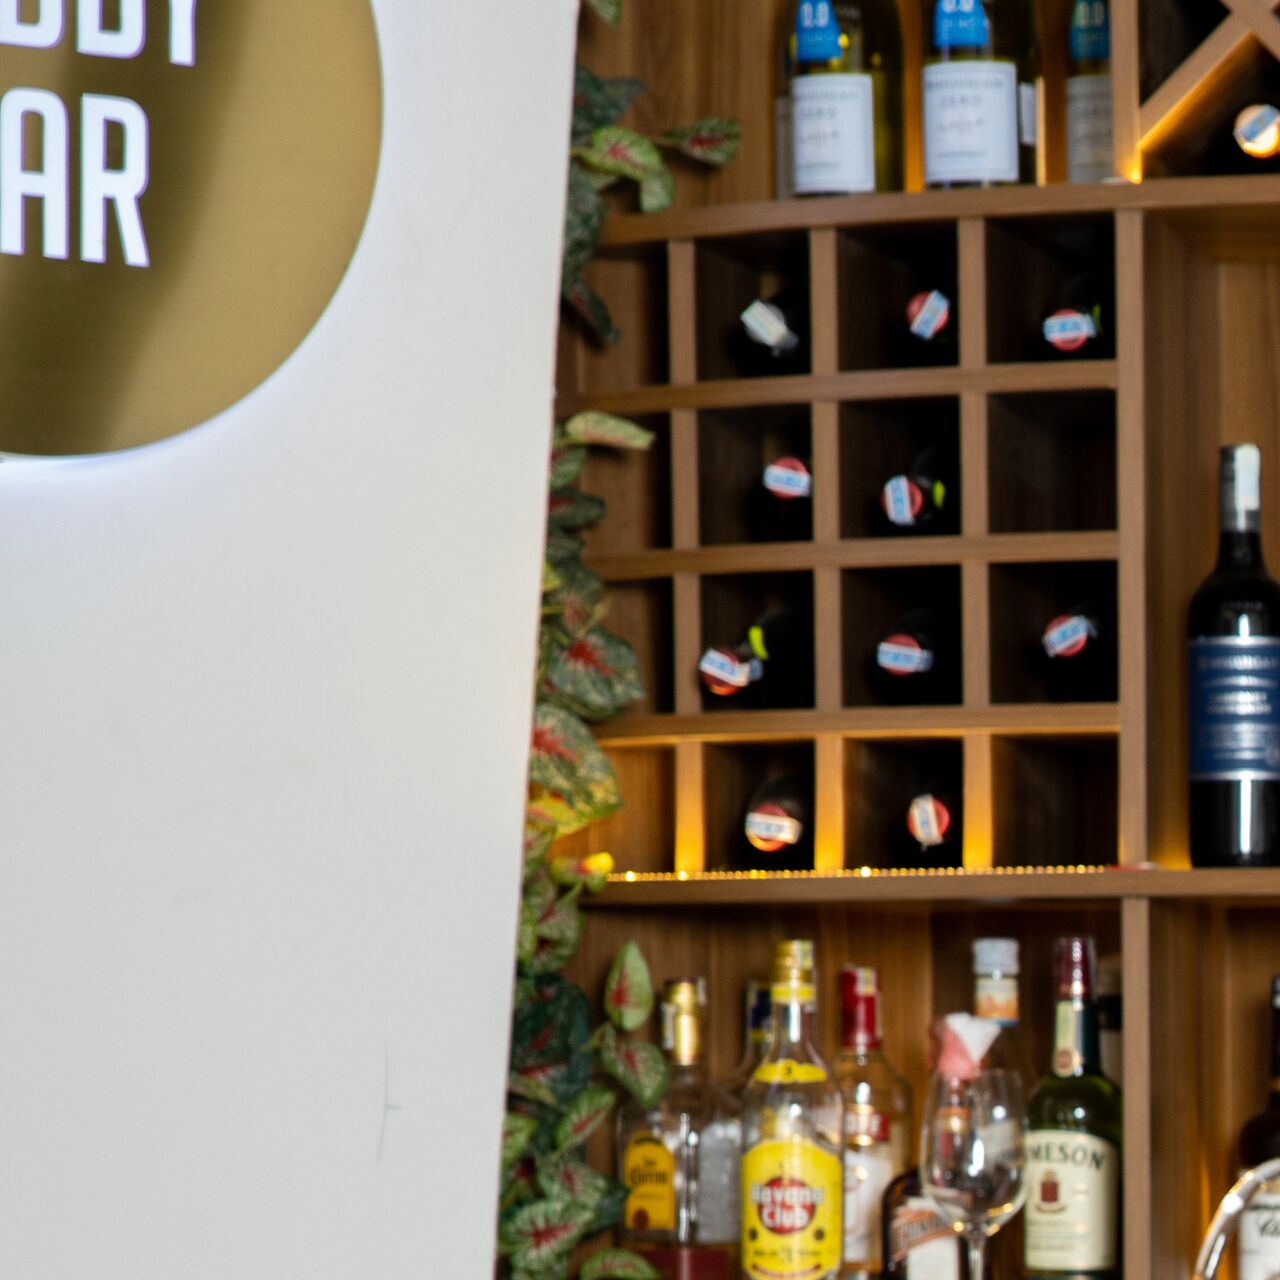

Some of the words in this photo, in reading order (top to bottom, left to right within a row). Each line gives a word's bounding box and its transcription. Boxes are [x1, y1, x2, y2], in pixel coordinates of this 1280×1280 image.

[1029, 1143, 1106, 1169] MESON
[752, 1184, 824, 1204] Havana
[761, 1206, 809, 1229] Club
